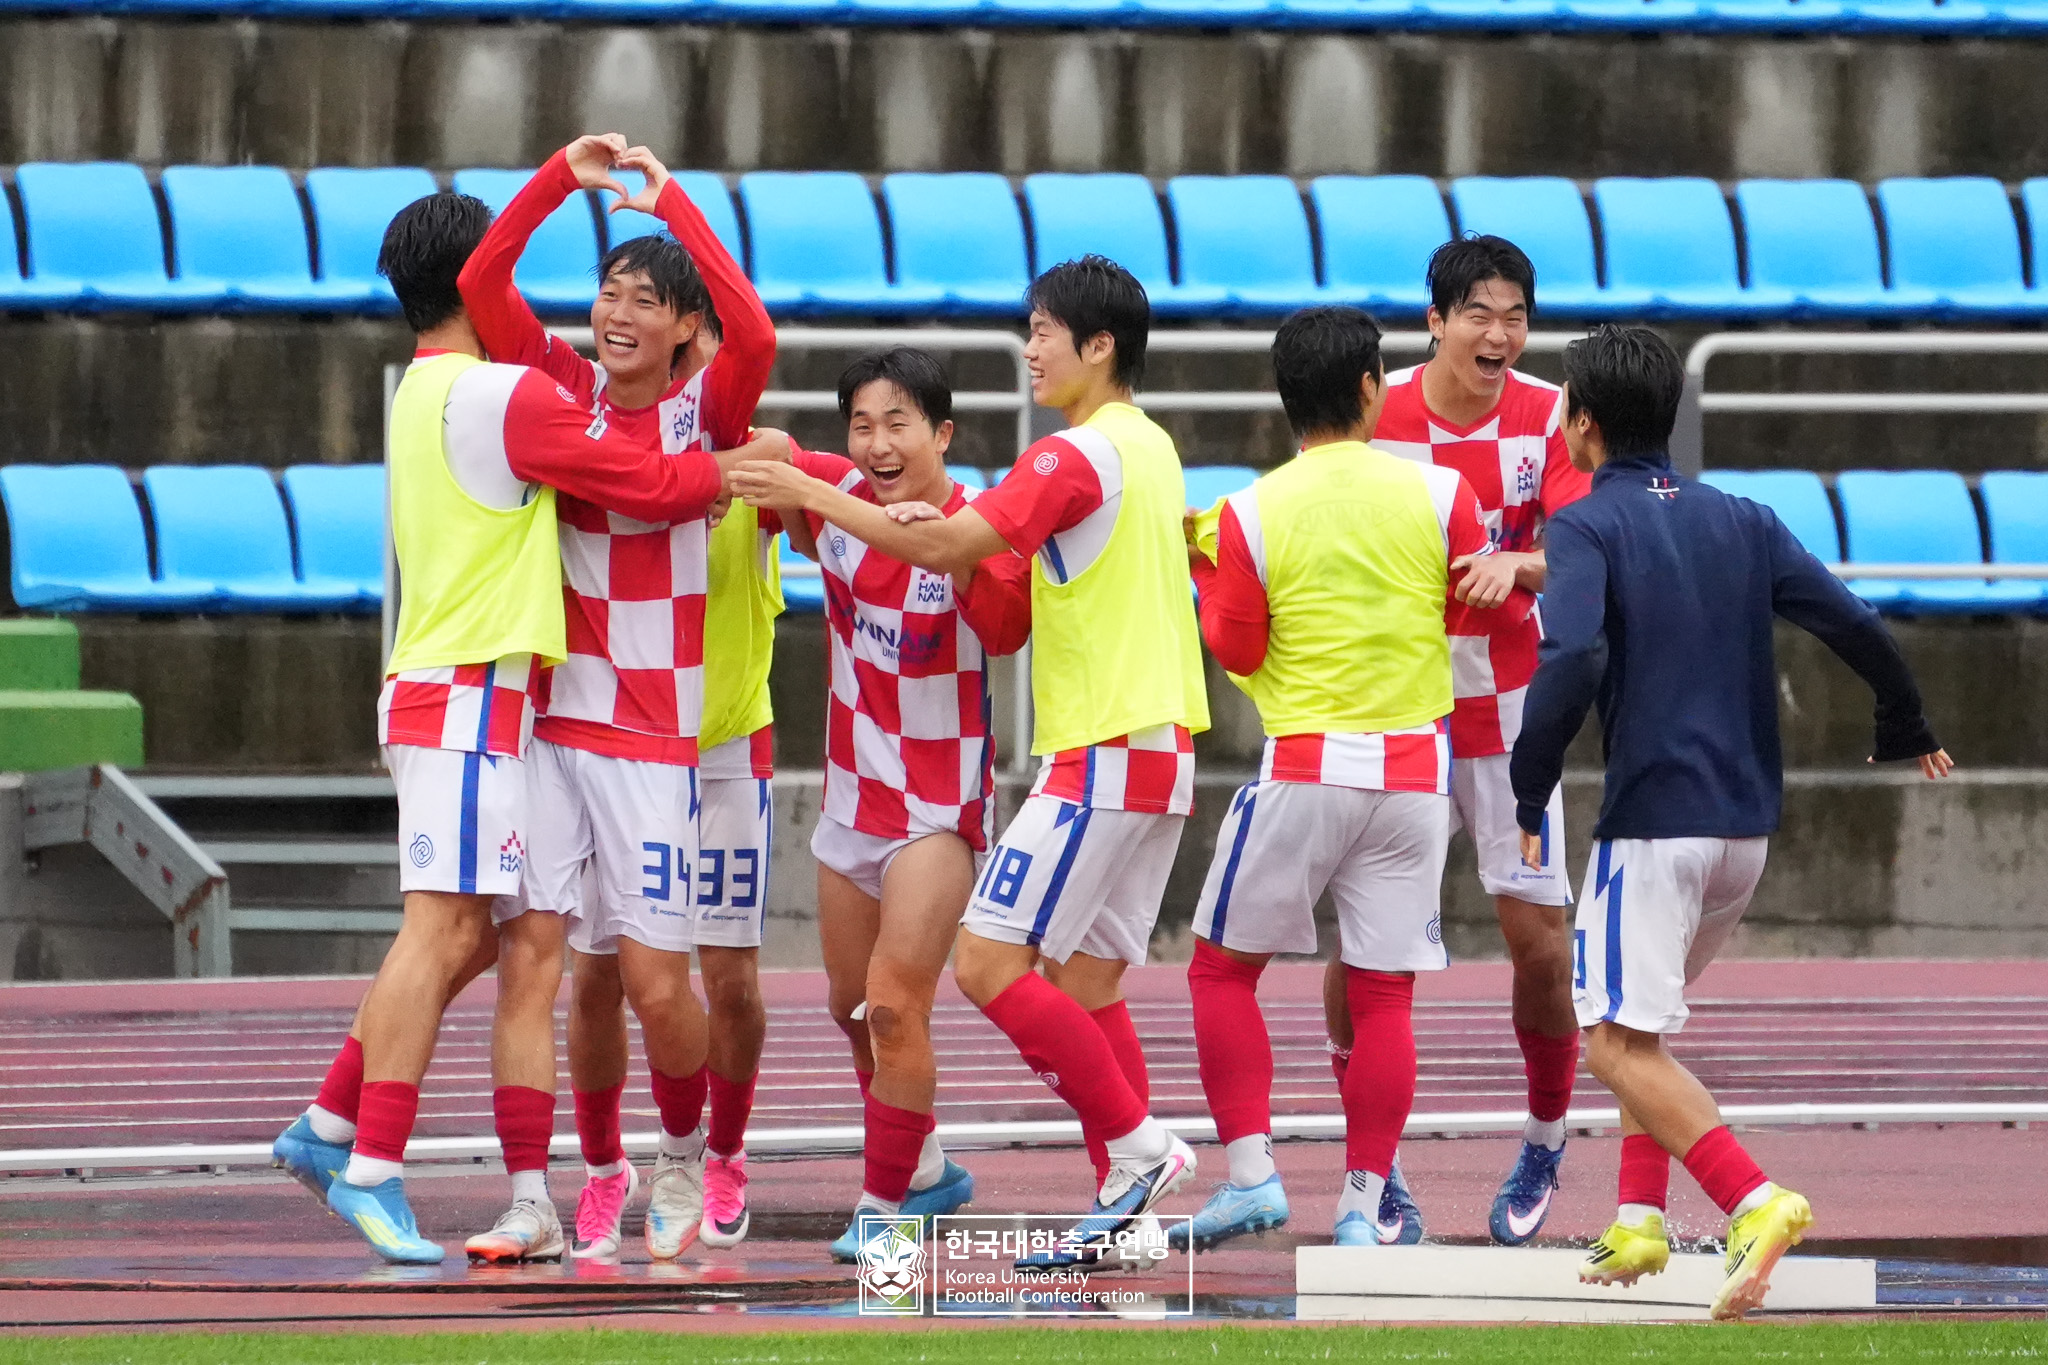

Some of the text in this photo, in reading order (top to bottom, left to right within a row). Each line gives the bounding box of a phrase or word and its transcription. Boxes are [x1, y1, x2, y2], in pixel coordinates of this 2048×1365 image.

[917, 592, 945, 602] NAM
[918, 581, 945, 593] HAN
[642, 841, 691, 907] 34
[697, 848, 759, 908] 33
[978, 844, 1034, 909] 18
